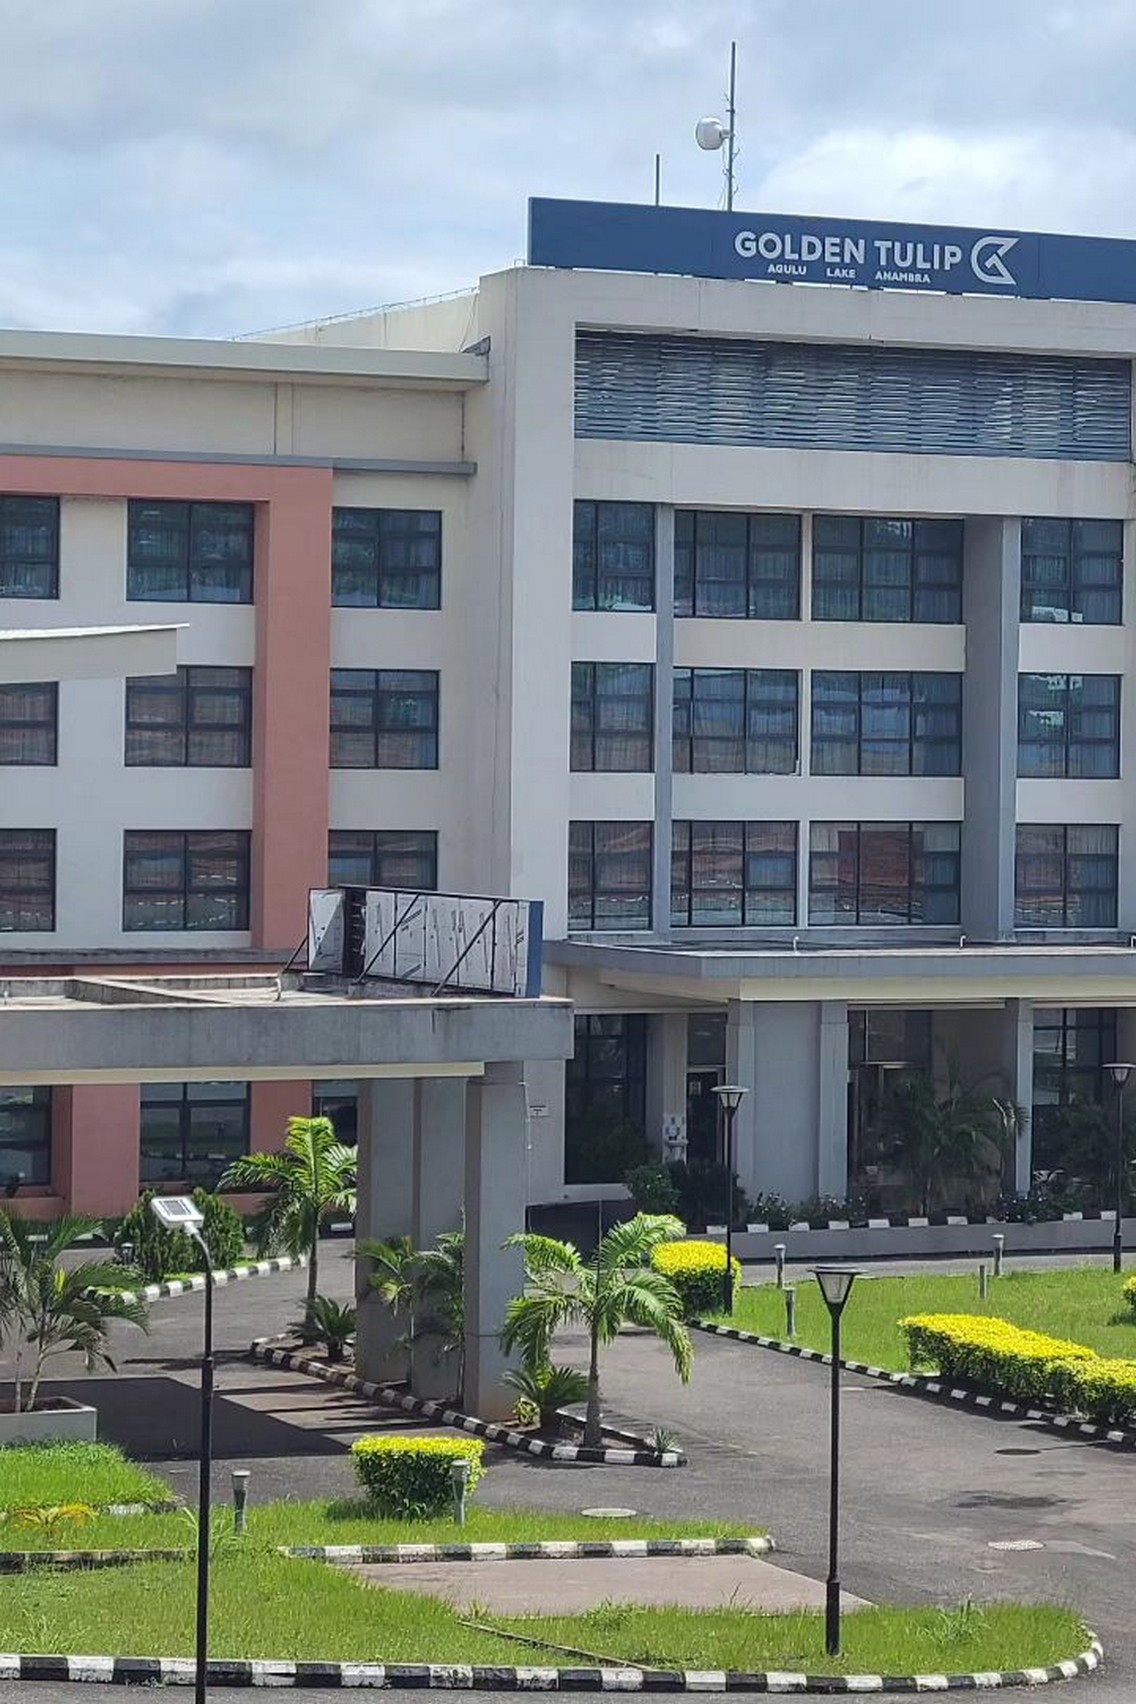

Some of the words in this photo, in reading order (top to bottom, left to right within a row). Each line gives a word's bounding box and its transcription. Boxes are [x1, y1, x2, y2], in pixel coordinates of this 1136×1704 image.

[734, 231, 865, 265] GOLDEN
[874, 240, 963, 271] TULIP
[767, 264, 807, 276] AGULU
[826, 267, 856, 279] LAKE
[875, 271, 931, 284] ANAMBRA
